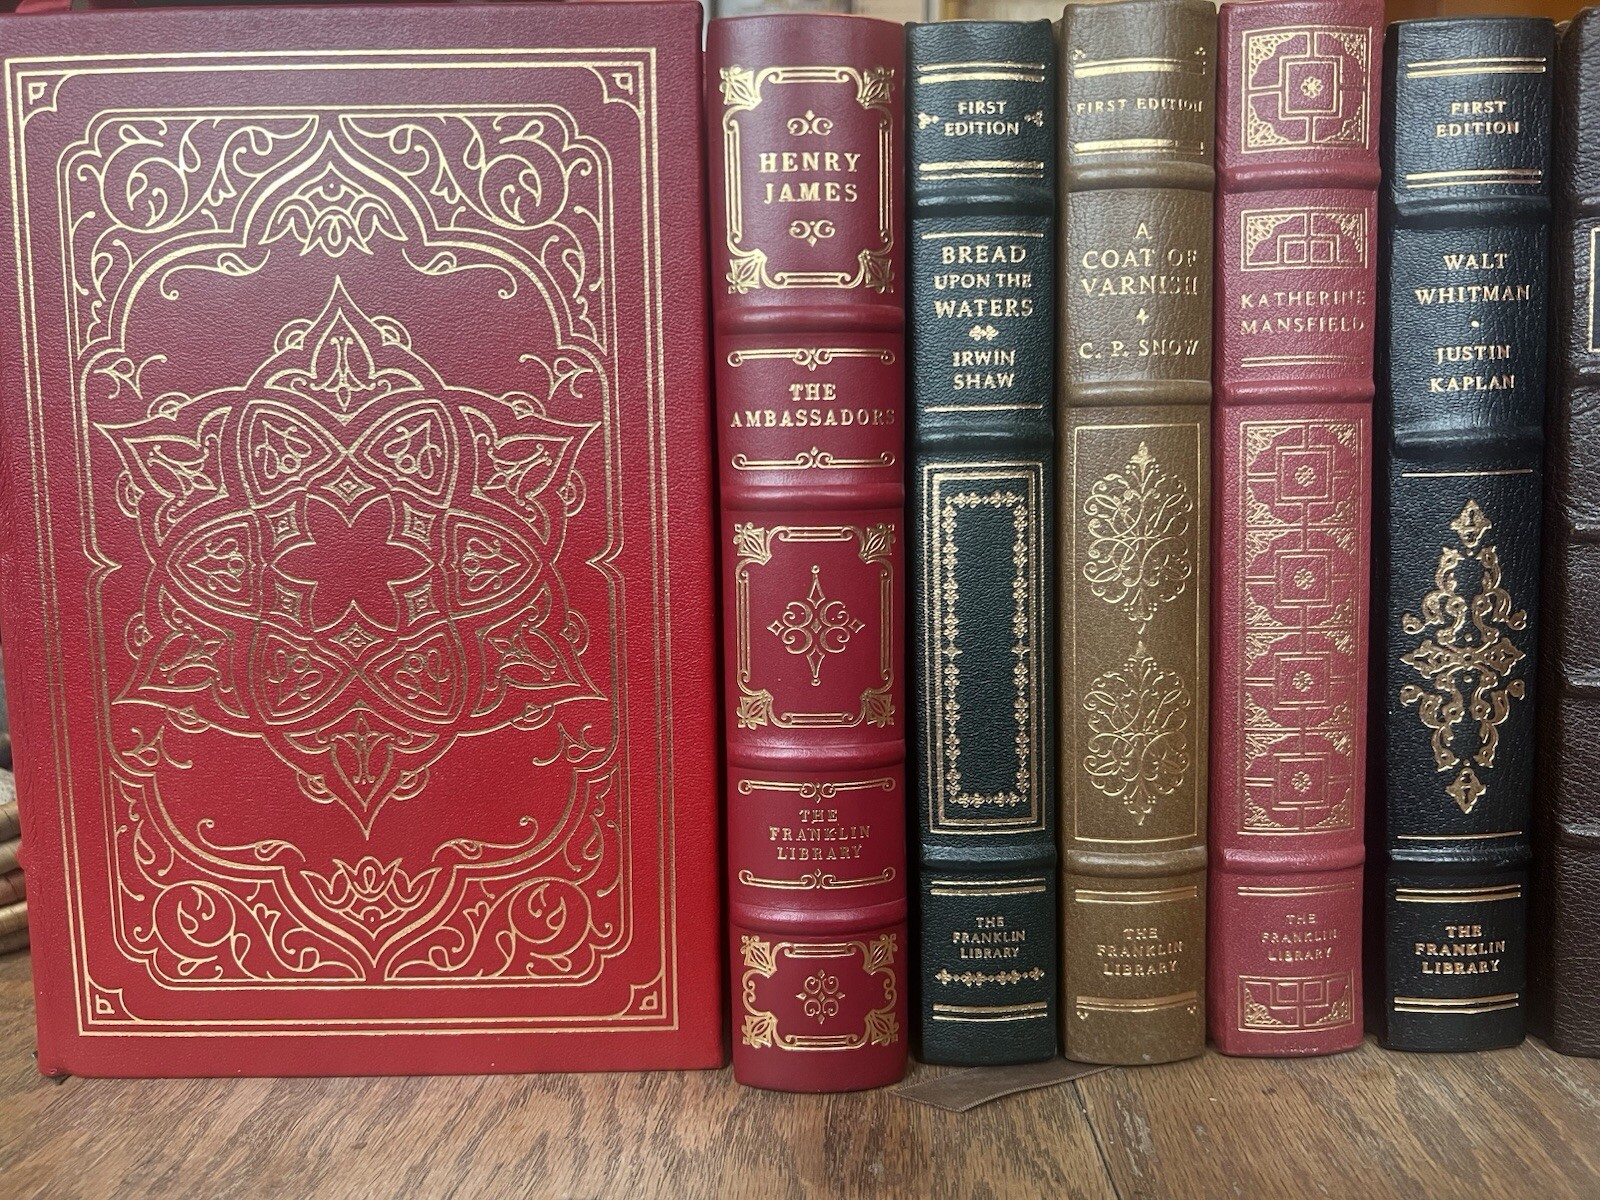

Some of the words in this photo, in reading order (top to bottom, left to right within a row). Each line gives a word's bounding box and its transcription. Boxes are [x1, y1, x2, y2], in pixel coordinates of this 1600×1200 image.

[957, 100, 1007, 115] FIRST
[1076, 98, 1127, 115] FIRST
[1136, 98, 1203, 113] EDITION
[1451, 100, 1508, 116] FIRST
[944, 120, 1020, 137] EDITION
[1435, 120, 1520, 138] EDITION
[759, 152, 861, 173] HENRY
[764, 182, 859, 205] JAMES
[1133, 222, 1153, 240] A
[942, 245, 1027, 265] BREAD
[1081, 248, 1156, 270] COAT
[1167, 248, 1197, 267] OF
[1442, 252, 1508, 271] WALT
[934, 273, 990, 290] UPON
[997, 272, 1032, 289] THE
[1081, 275, 1198, 297] VARNISH
[1240, 289, 1366, 309] KATHERINE
[1415, 284, 1530, 306] WHITMAN
[934, 299, 1033, 319] WATERS
[1240, 316, 1364, 336] MANSFIELD
[1078, 342, 1102, 359] C.
[1110, 340, 1130, 358] P.
[1138, 339, 1199, 356] SNOW
[1436, 344, 1510, 365] JUSTIN
[952, 350, 1015, 367] IRWIN
[953, 373, 1015, 390] SHAW
[1430, 374, 1515, 393] KAPLAN
[788, 383, 837, 401] THE
[730, 409, 896, 429] AMBASSADORS
[799, 808, 838, 824] THE
[769, 825, 871, 842] FRANKLIN
[776, 844, 863, 861] LIBRARY
[975, 916, 1005, 929] THE
[1285, 913, 1316, 926] THE
[952, 929, 1027, 944] FRANKLIN
[1122, 927, 1158, 940] THE
[1261, 928, 1337, 944] FRANKLIN
[1445, 924, 1483, 939] THE
[960, 946, 1020, 960] LIBRARY
[1097, 941, 1183, 958] FRANKLIN
[1268, 947, 1332, 963] LIBRARY
[1415, 940, 1506, 957] FRANKLIN
[1103, 960, 1178, 977] LIBRARY
[1421, 959, 1501, 975] LIBRARY
